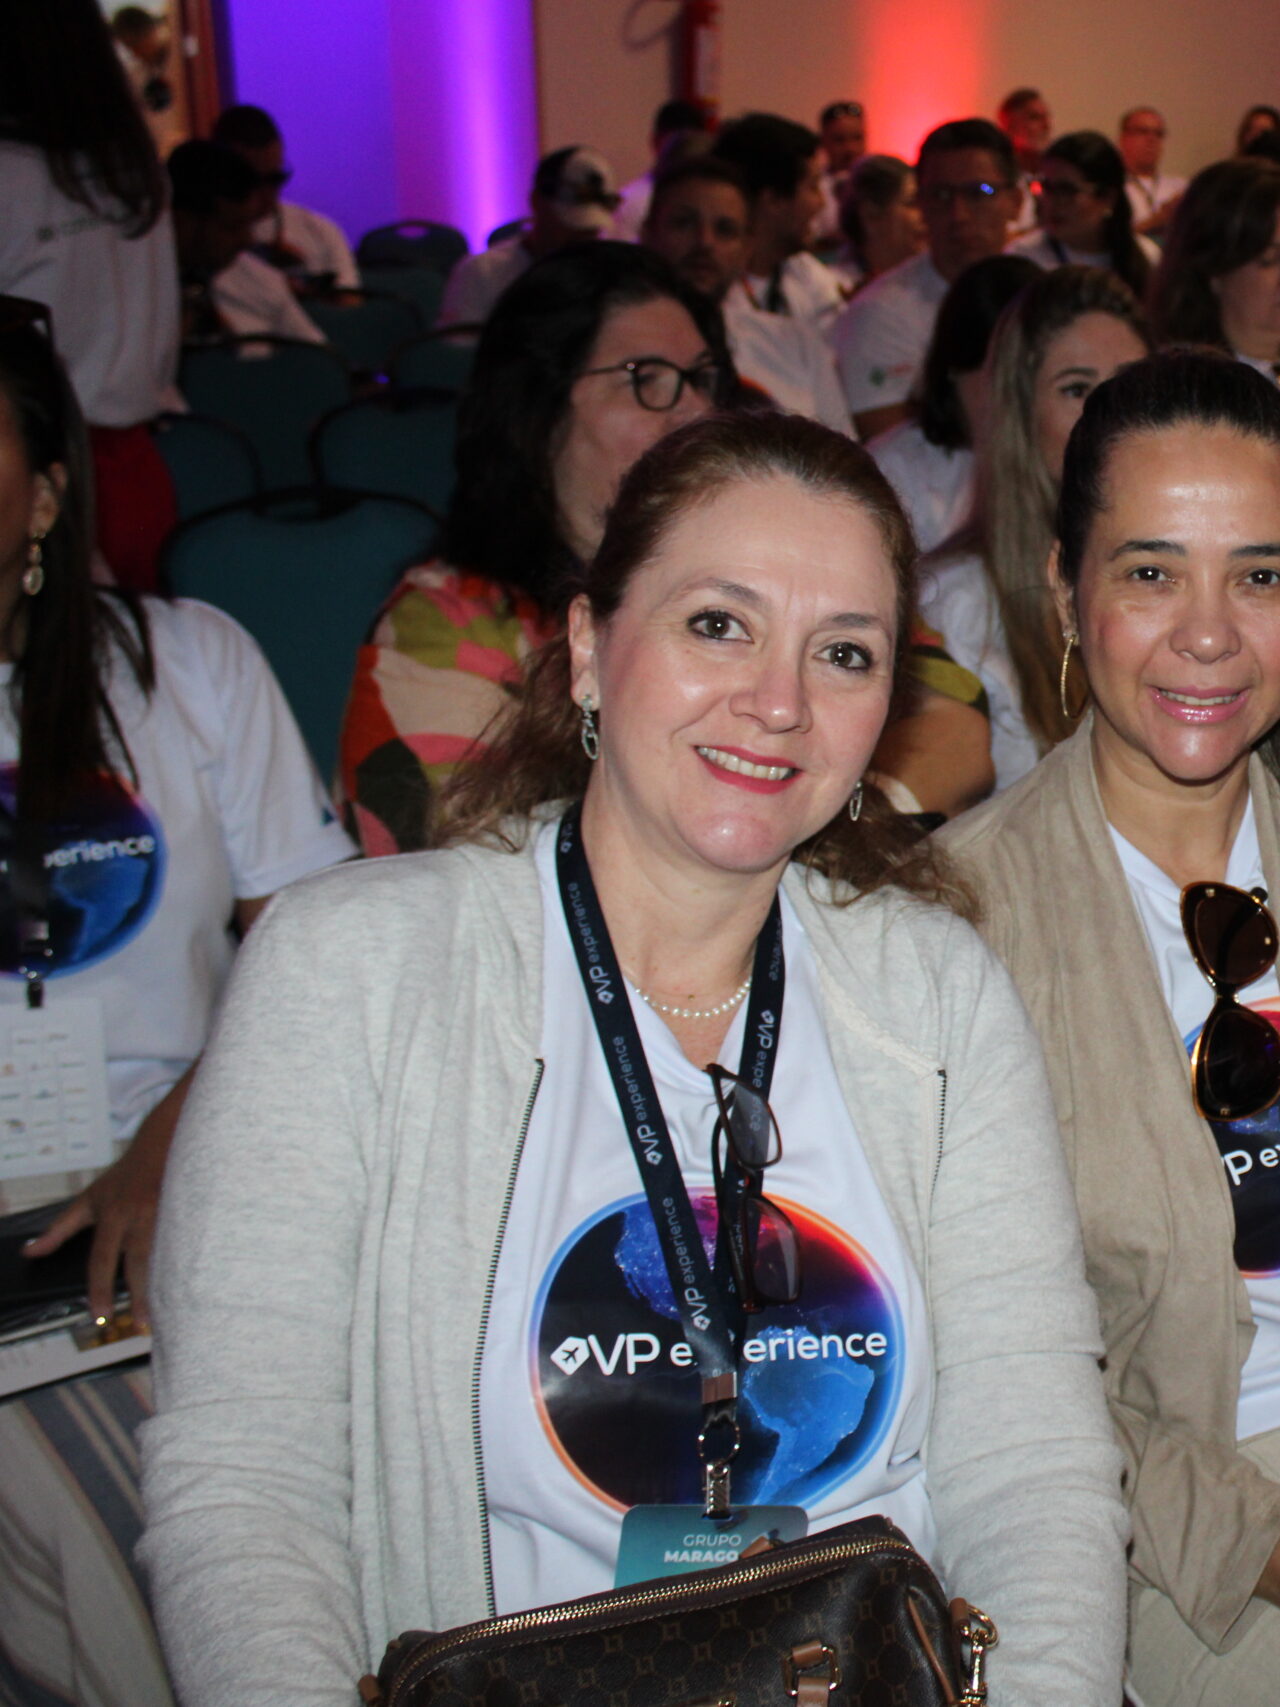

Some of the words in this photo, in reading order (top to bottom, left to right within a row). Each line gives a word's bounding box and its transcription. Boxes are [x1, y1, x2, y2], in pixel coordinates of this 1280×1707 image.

[567, 882, 601, 964] experience
[589, 965, 613, 996] VP
[757, 1023, 776, 1050] VP
[612, 1036, 648, 1121] experience
[637, 1124, 660, 1154] VP
[662, 1197, 696, 1284] experience
[684, 1287, 708, 1318] VP
[587, 1332, 661, 1376] VP
[669, 1331, 888, 1368] eerience
[682, 1533, 742, 1547] GRUPO
[663, 1549, 740, 1563] MARAGO
